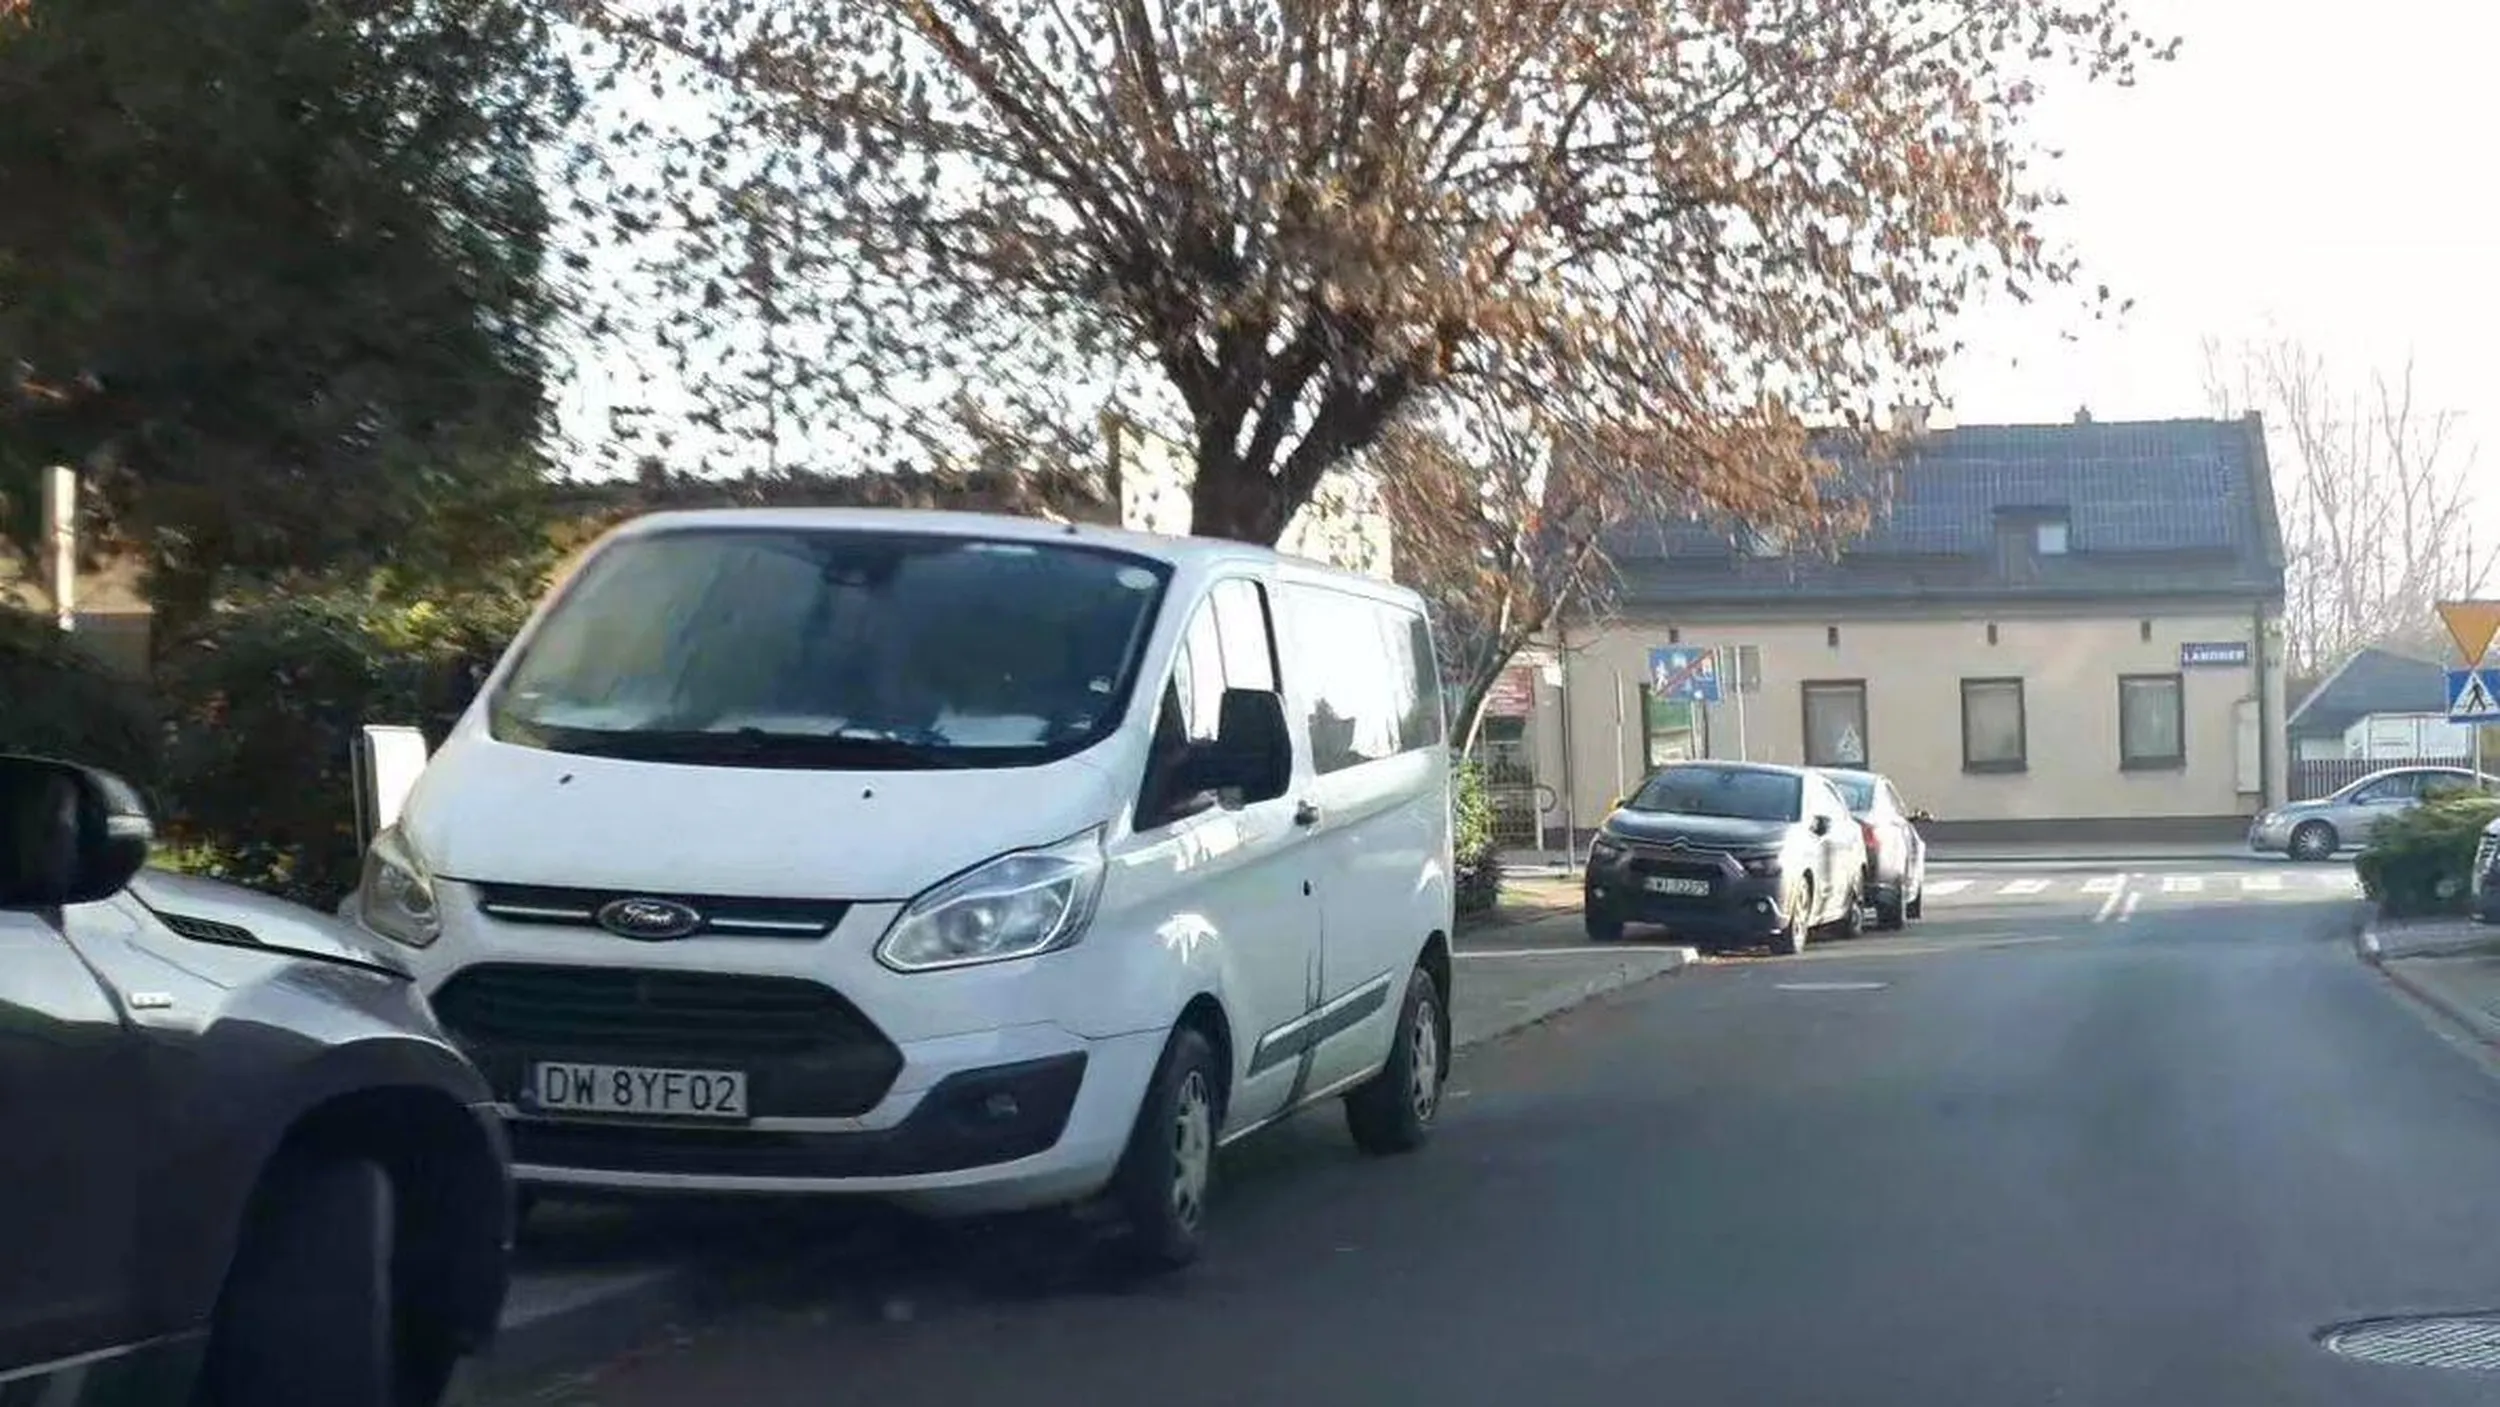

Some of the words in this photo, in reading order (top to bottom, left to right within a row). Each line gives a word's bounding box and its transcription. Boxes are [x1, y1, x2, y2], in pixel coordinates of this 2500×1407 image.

[623, 903, 677, 926] Ford
[546, 1066, 595, 1105] DW
[612, 1069, 738, 1113] 8YF02
